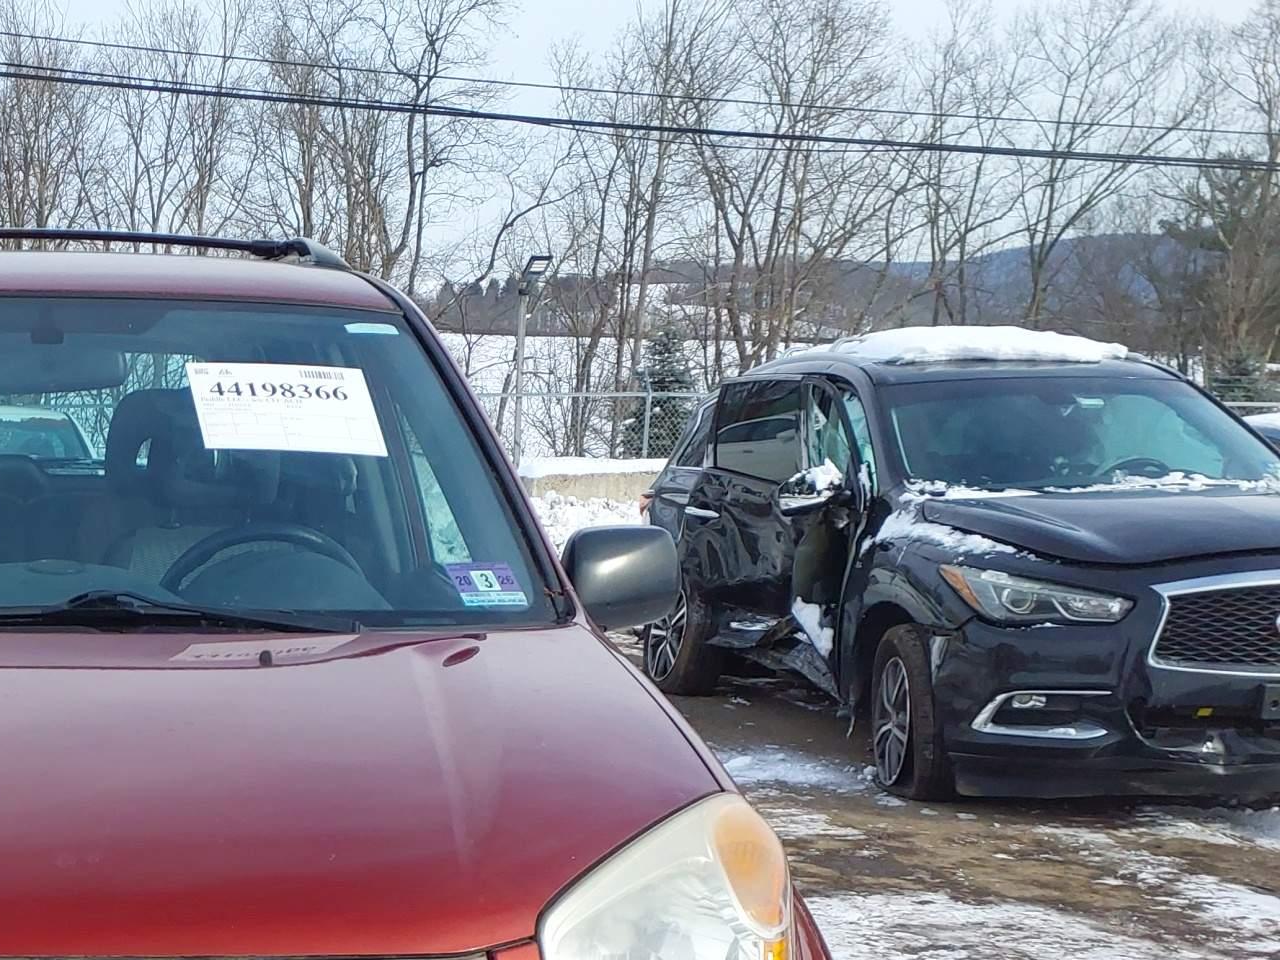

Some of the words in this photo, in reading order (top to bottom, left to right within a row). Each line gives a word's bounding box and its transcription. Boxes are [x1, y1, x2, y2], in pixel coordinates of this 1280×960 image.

[210, 381, 348, 401] 44198366
[456, 575, 472, 586] 20
[480, 573, 493, 589] 3
